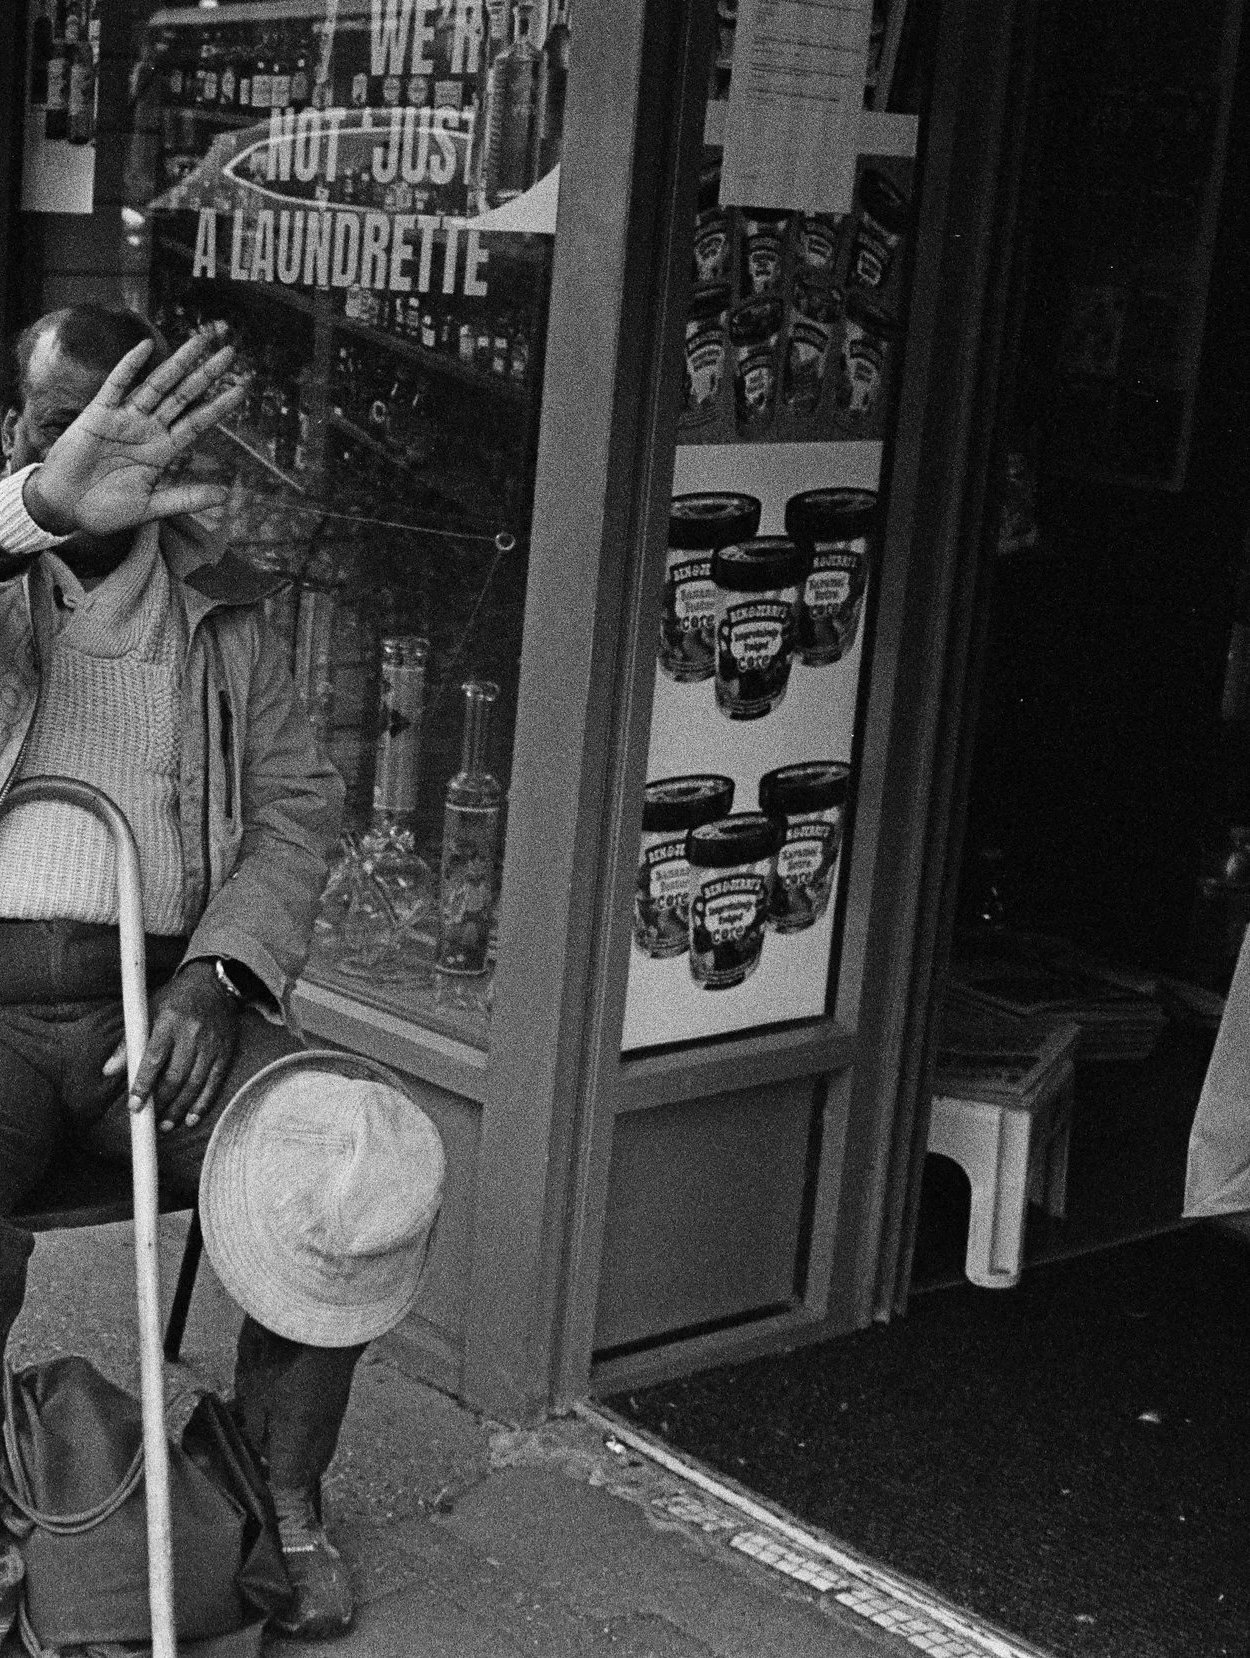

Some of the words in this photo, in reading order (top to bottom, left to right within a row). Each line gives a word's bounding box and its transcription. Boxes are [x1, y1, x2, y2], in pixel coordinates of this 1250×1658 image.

[266, 106, 347, 182] NOT
[192, 207, 217, 279] A
[230, 208, 490, 297] LAUNDRETTE
